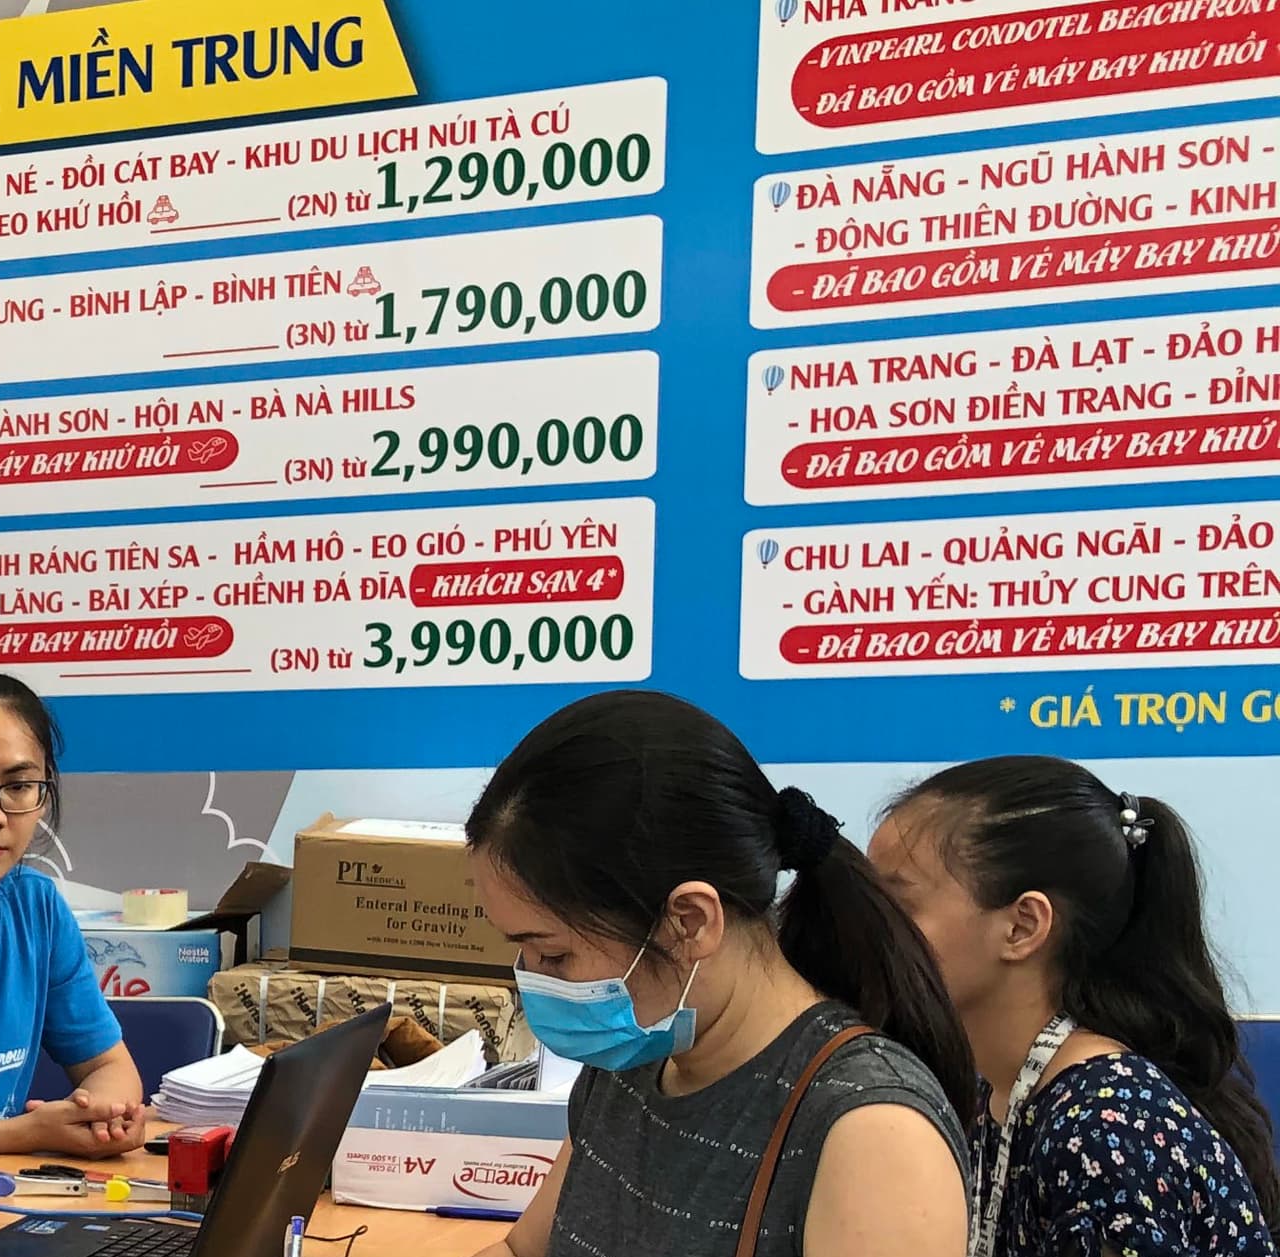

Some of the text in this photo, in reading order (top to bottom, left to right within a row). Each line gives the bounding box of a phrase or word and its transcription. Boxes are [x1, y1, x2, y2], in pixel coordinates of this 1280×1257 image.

[18, 28, 152, 108] MIỀN
[172, 16, 363, 88] TRUNG
[7, 165, 37, 196] NÉ
[62, 154, 104, 190] ĐỒI
[114, 152, 162, 183] CÁT
[171, 150, 219, 178] BAY
[246, 141, 300, 169] KHU
[311, 135, 347, 162] DU
[357, 126, 418, 162] LỊCH
[429, 114, 476, 148] NÚI
[486, 108, 521, 141] TÀ
[531, 102, 569, 136] CÚ
[288, 131, 651, 221] (2N) từ 1,290,000
[287, 270, 646, 349] (3N) từ 1,790,000
[785, 514, 1273, 571] CHU LAI QUẢNG NGÃI ĐẢO
[271, 614, 633, 673] (3N) từ 3,990,000
[1030, 686, 1226, 732] GIÁ TRỌN
[338, 860, 367, 882] PT
[356, 896, 469, 919] Enteral Feeding
[387, 917, 467, 938] for Gravity
[403, 1156, 436, 1175] A4
